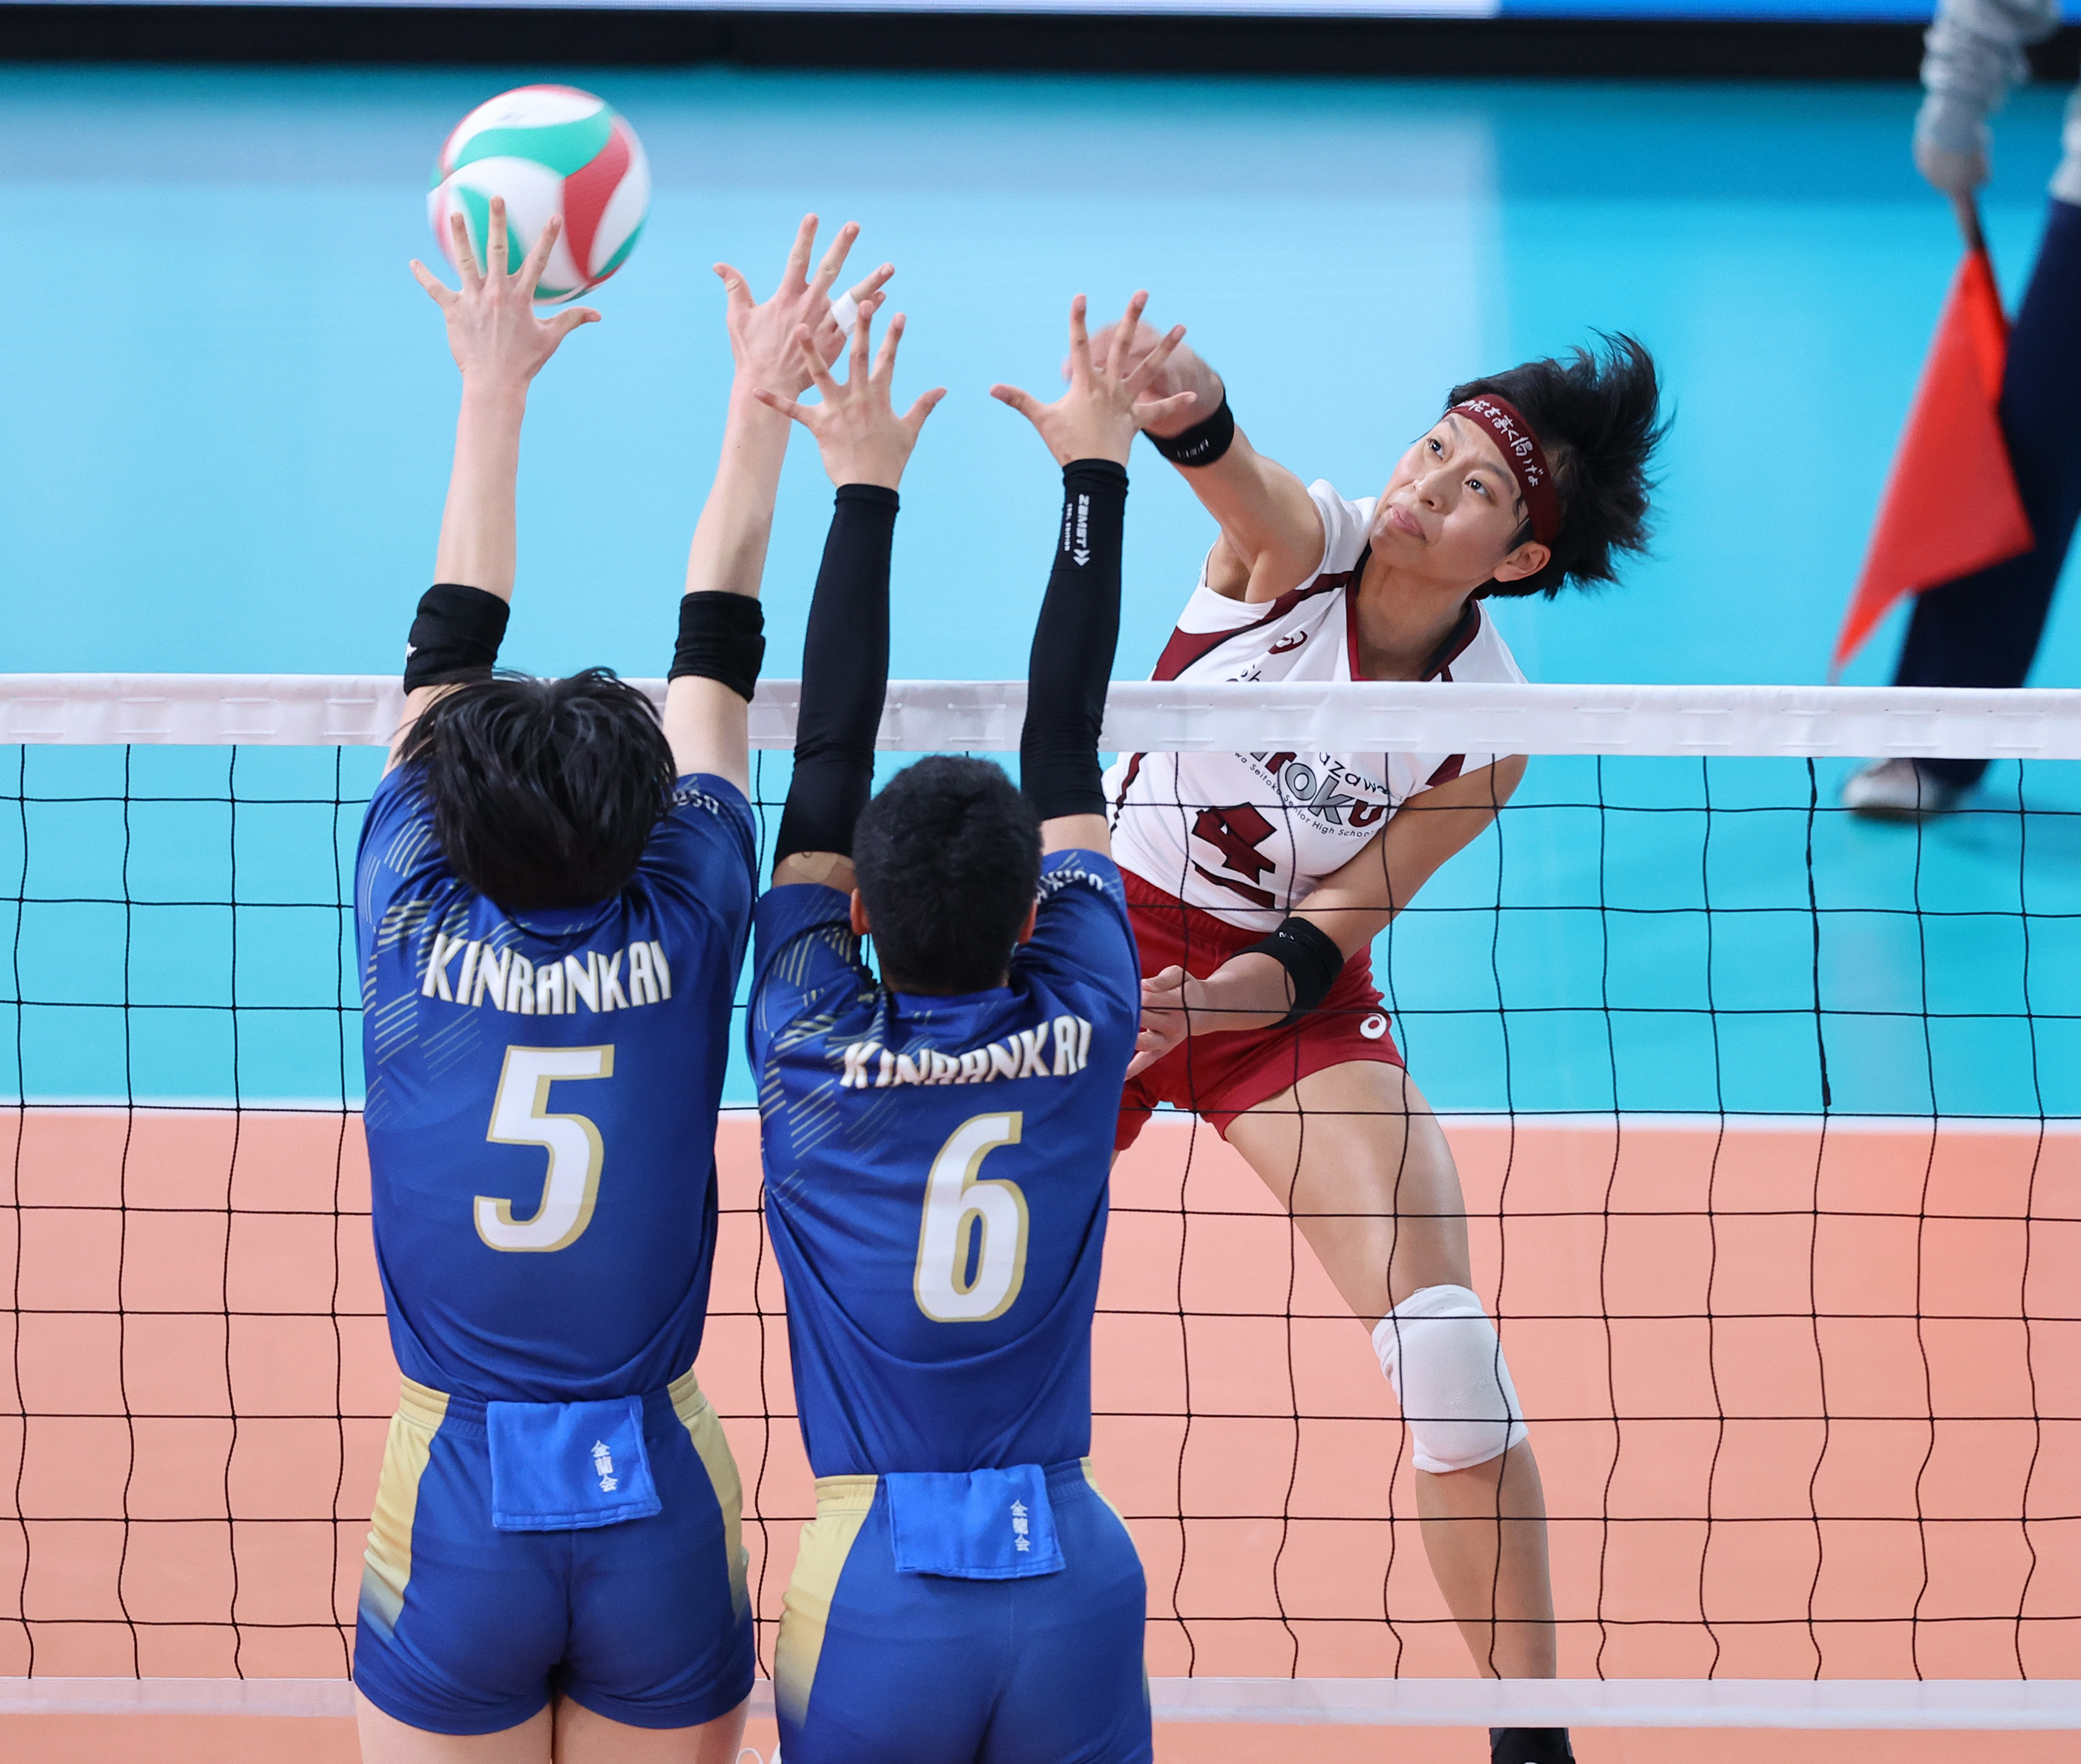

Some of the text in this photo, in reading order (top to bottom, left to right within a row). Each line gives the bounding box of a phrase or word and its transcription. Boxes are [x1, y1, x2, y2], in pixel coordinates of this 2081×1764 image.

[1283, 794, 1311, 823] Senior
[1312, 820, 1335, 834] High
[422, 932, 672, 1015] KINRANKAI
[839, 1014, 1092, 1089] KINRANKAI
[473, 1044, 615, 1253] 5
[913, 1111, 1029, 1323] 6
